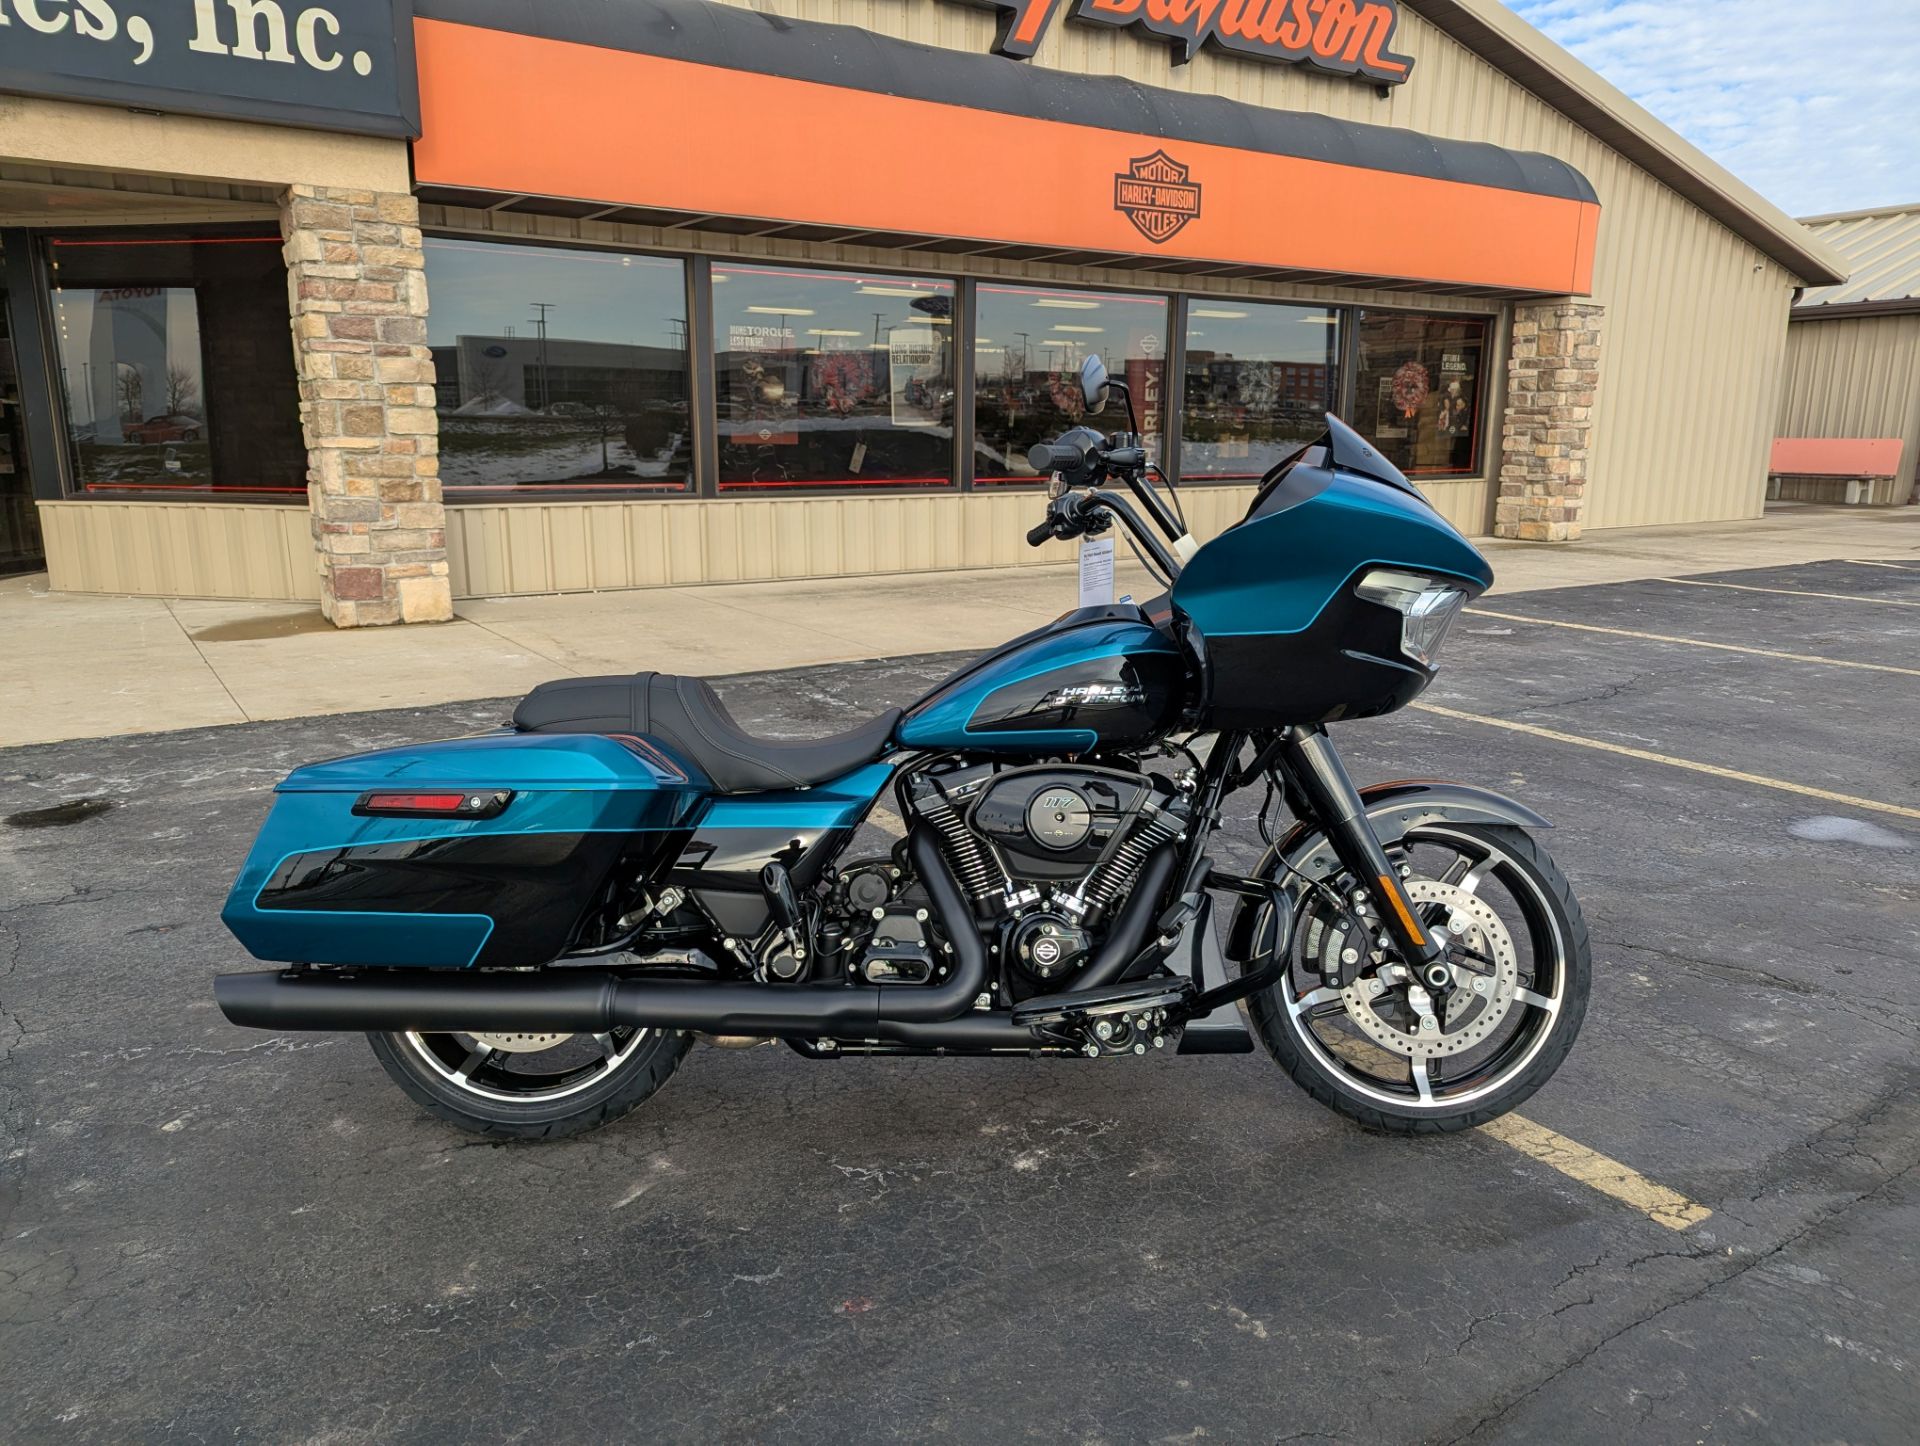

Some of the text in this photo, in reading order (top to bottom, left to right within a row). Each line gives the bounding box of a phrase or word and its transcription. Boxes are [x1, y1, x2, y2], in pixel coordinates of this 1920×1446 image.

[189, 0, 372, 76] Inc.
[1140, 161, 1180, 183] MOTOR
[1121, 183, 1195, 209] HARLEY-DAVIDSON
[1138, 211, 1178, 234] CYCLES
[747, 326, 795, 338] TORQUE.
[1043, 796, 1077, 808] 117
